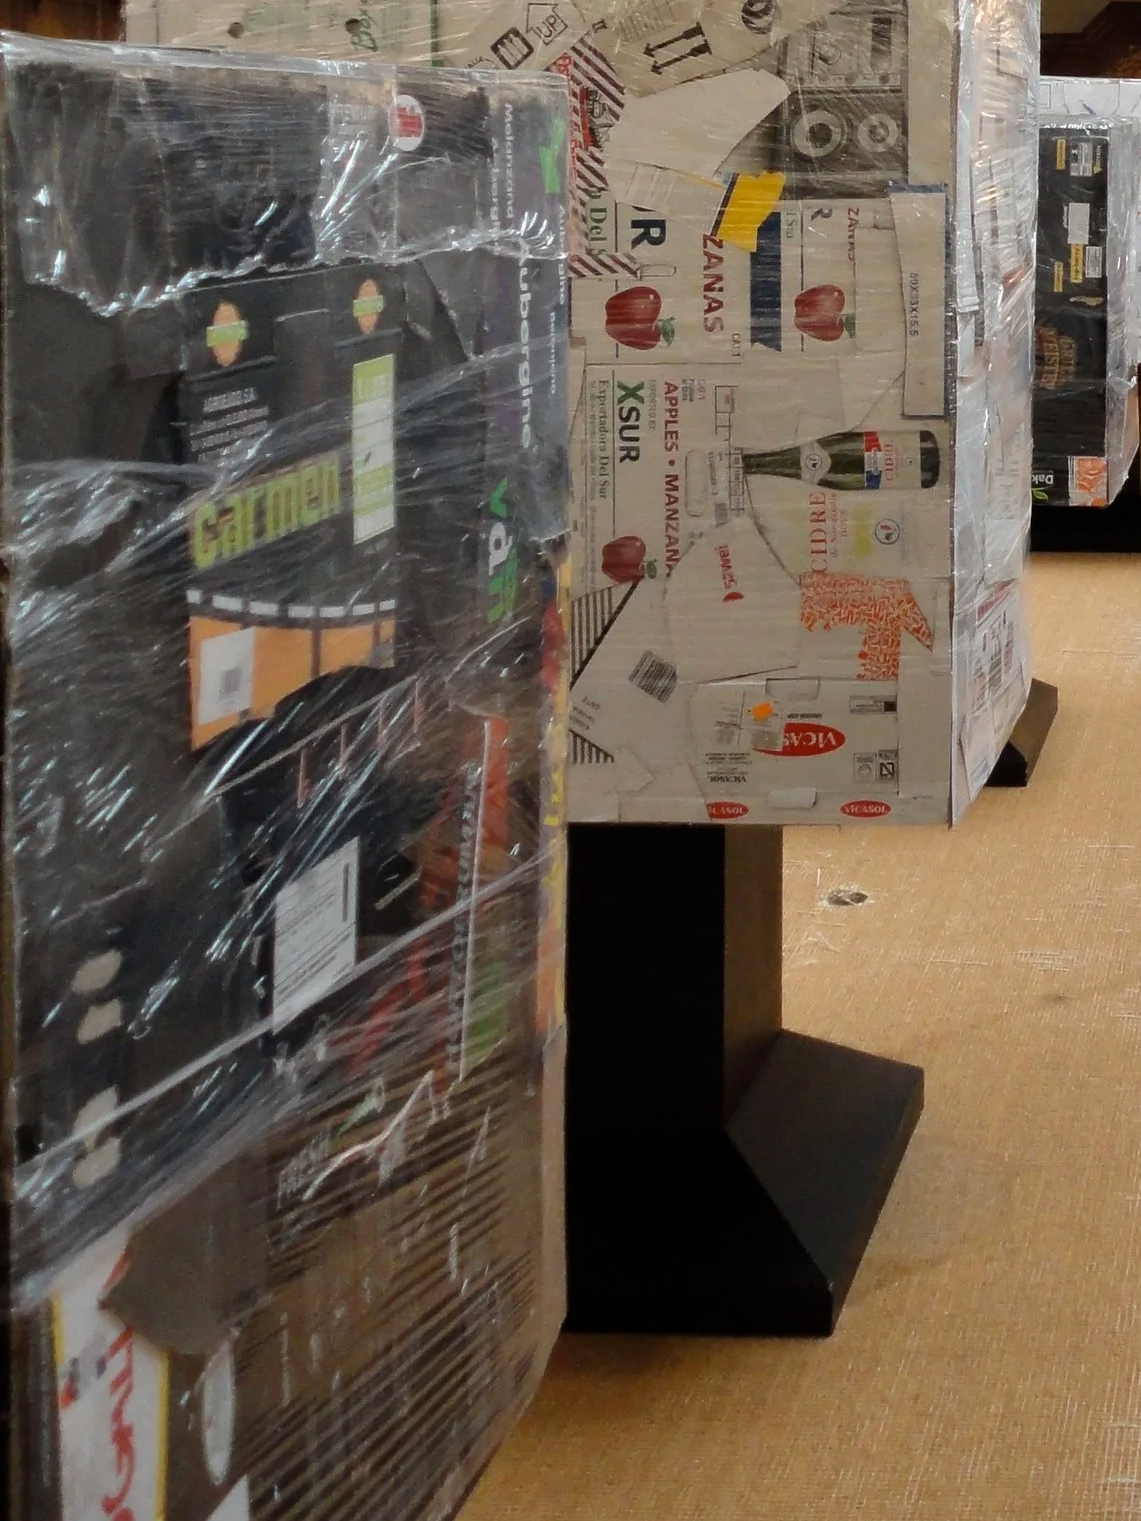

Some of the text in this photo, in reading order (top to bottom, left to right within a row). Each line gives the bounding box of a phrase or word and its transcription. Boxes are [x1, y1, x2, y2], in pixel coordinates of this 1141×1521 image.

[503, 102, 515, 219] Melanzana
[589, 206, 608, 242] Del
[630, 218, 668, 250] R
[518, 238, 533, 449] Aubergine
[616, 380, 645, 464] XSUR
[664, 381, 680, 452] APPLES
[599, 455, 610, 477] Del
[599, 479, 609, 500] Sur
[808, 491, 828, 573] CIDRE
